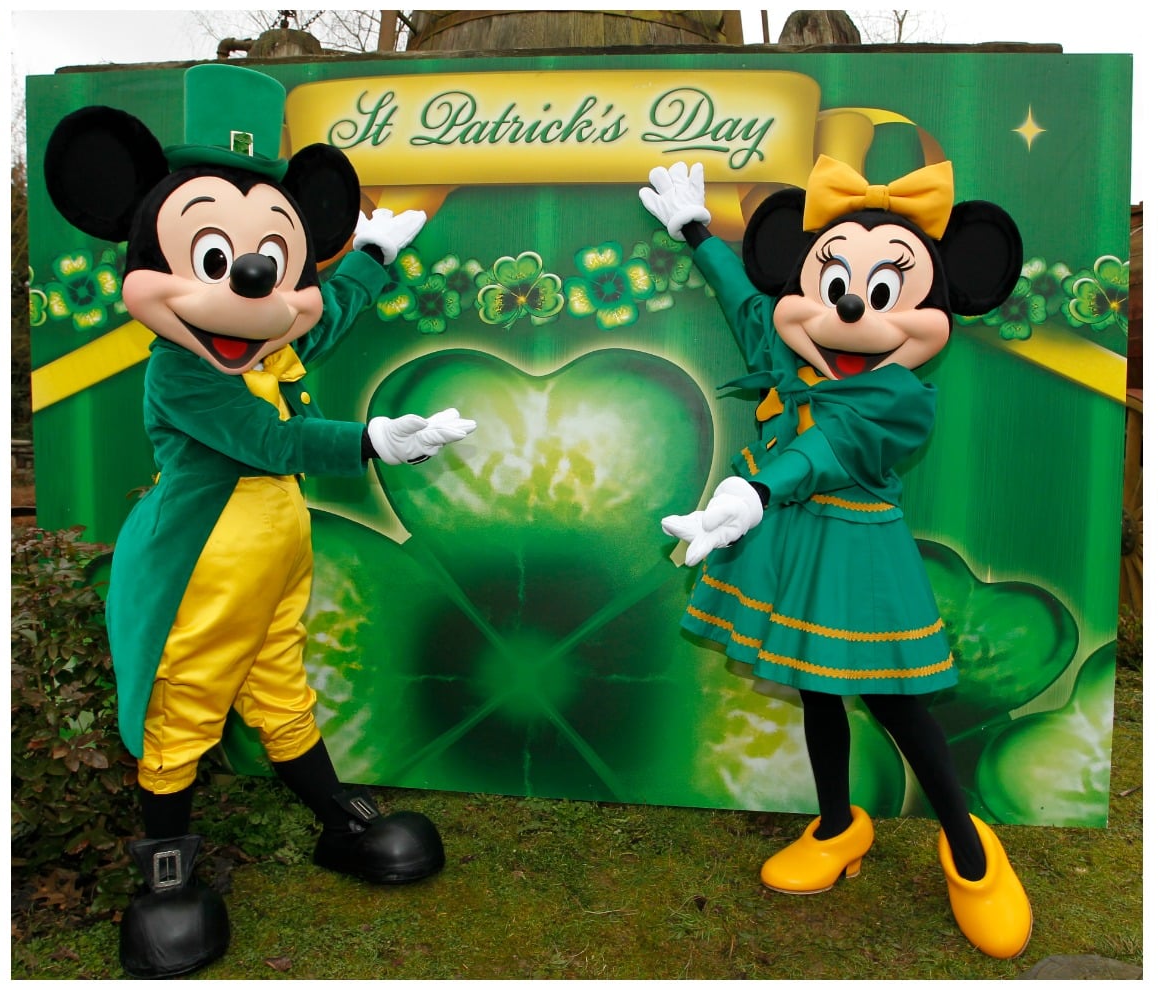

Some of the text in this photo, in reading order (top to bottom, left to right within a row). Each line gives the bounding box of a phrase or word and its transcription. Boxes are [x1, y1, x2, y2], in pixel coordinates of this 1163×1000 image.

[327, 86, 775, 170] St Patrick's Day
